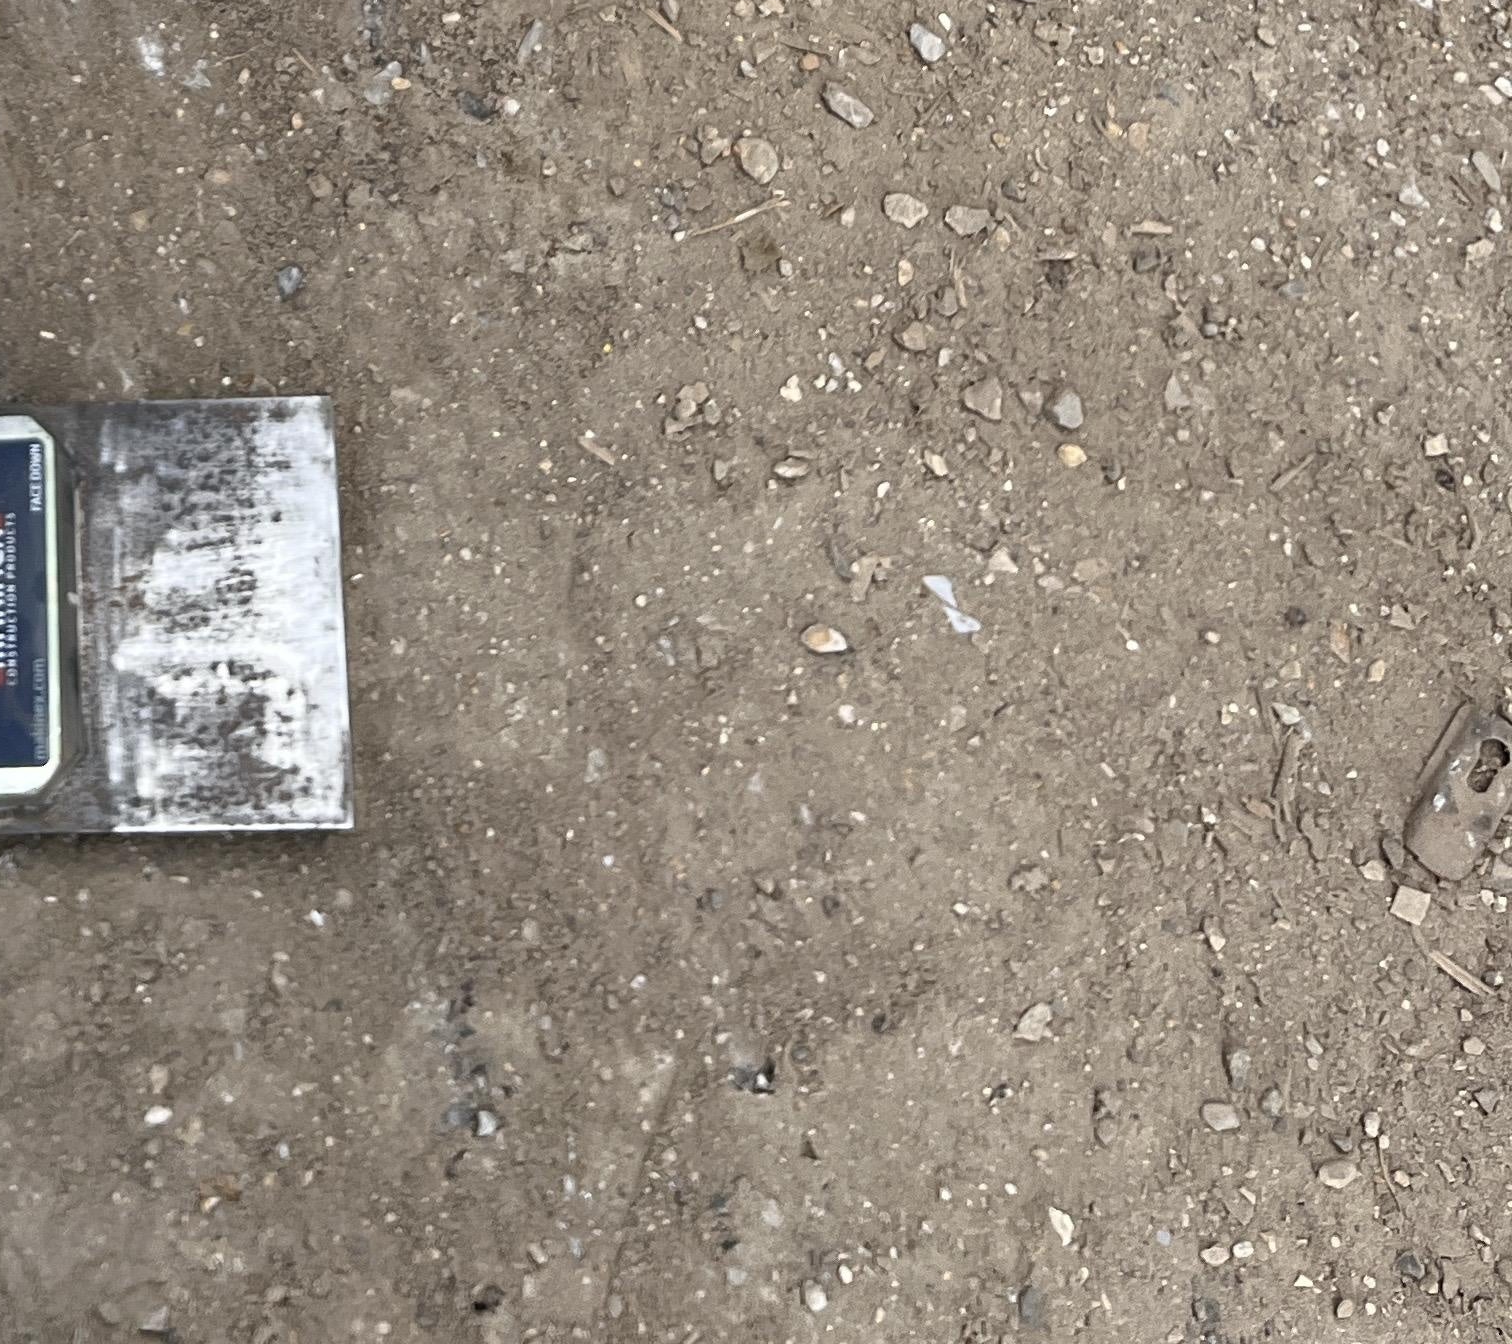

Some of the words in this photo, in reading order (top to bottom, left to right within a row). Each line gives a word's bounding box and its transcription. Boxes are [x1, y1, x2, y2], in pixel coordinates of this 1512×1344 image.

[29, 443, 44, 480] DOWN
[29, 482, 42, 512] FACE
[4, 512, 17, 580] PRODUCTS
[5, 585, 18, 687] CONSTRUCTION
[32, 657, 47, 763] makinex.com
